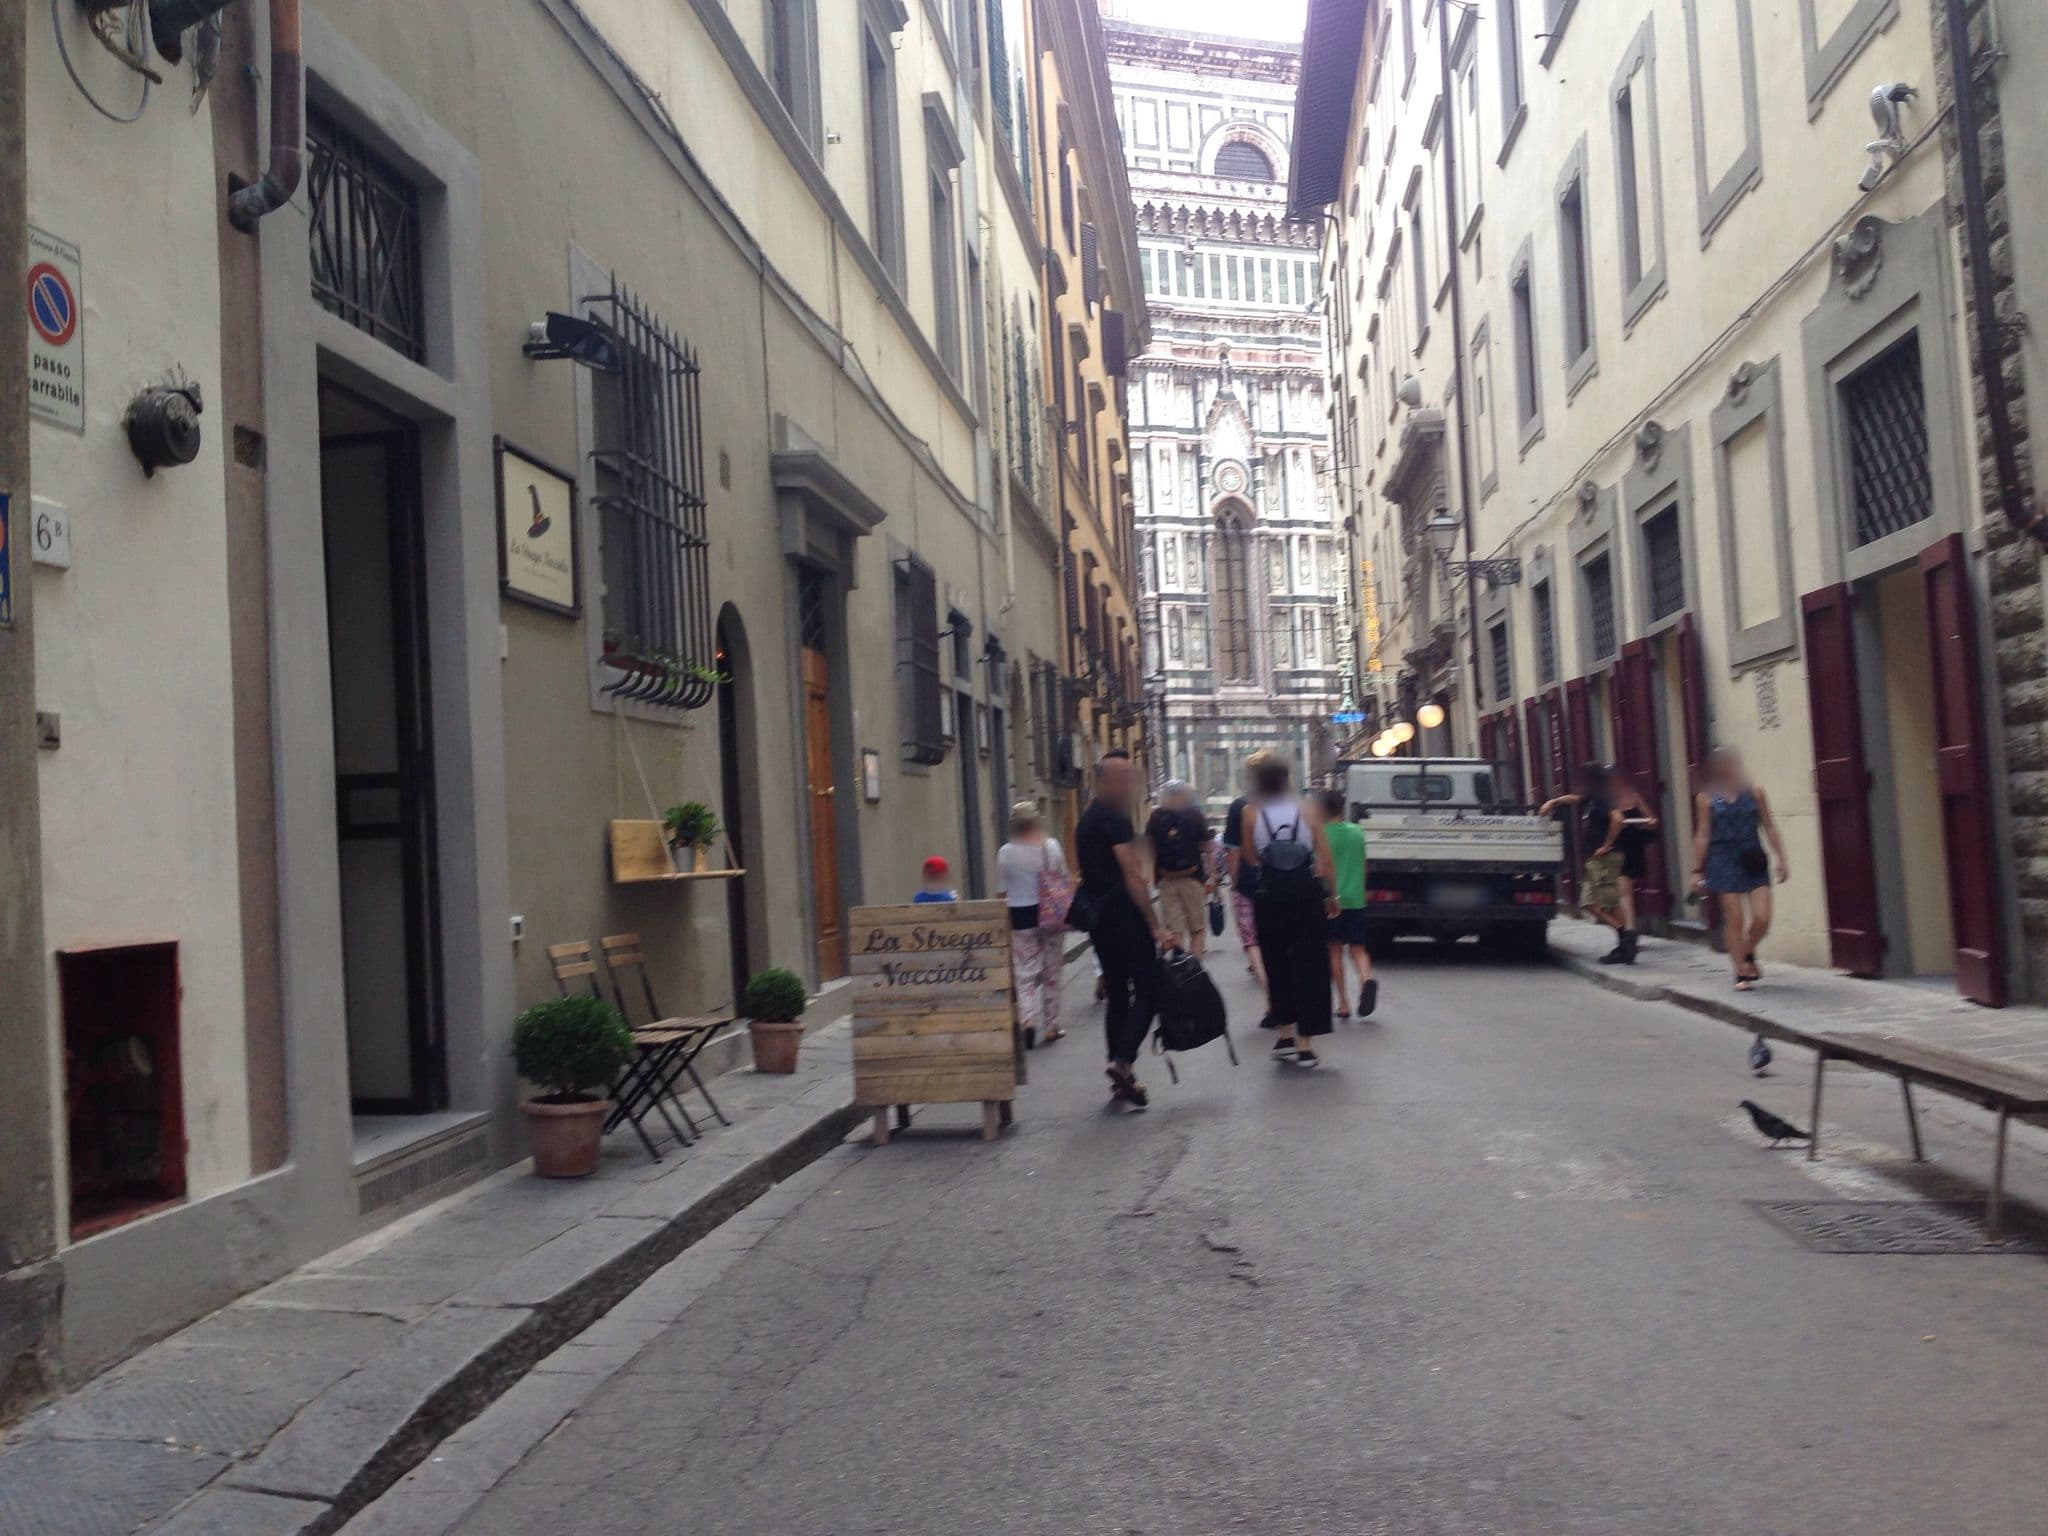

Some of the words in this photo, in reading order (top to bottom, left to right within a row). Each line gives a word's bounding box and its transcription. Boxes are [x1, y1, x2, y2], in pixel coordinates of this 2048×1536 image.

[34, 353, 71, 379] passo
[29, 378, 80, 407] arrabile
[863, 927, 902, 952] La
[911, 926, 994, 959] Strega
[872, 956, 988, 988] Nocciola
